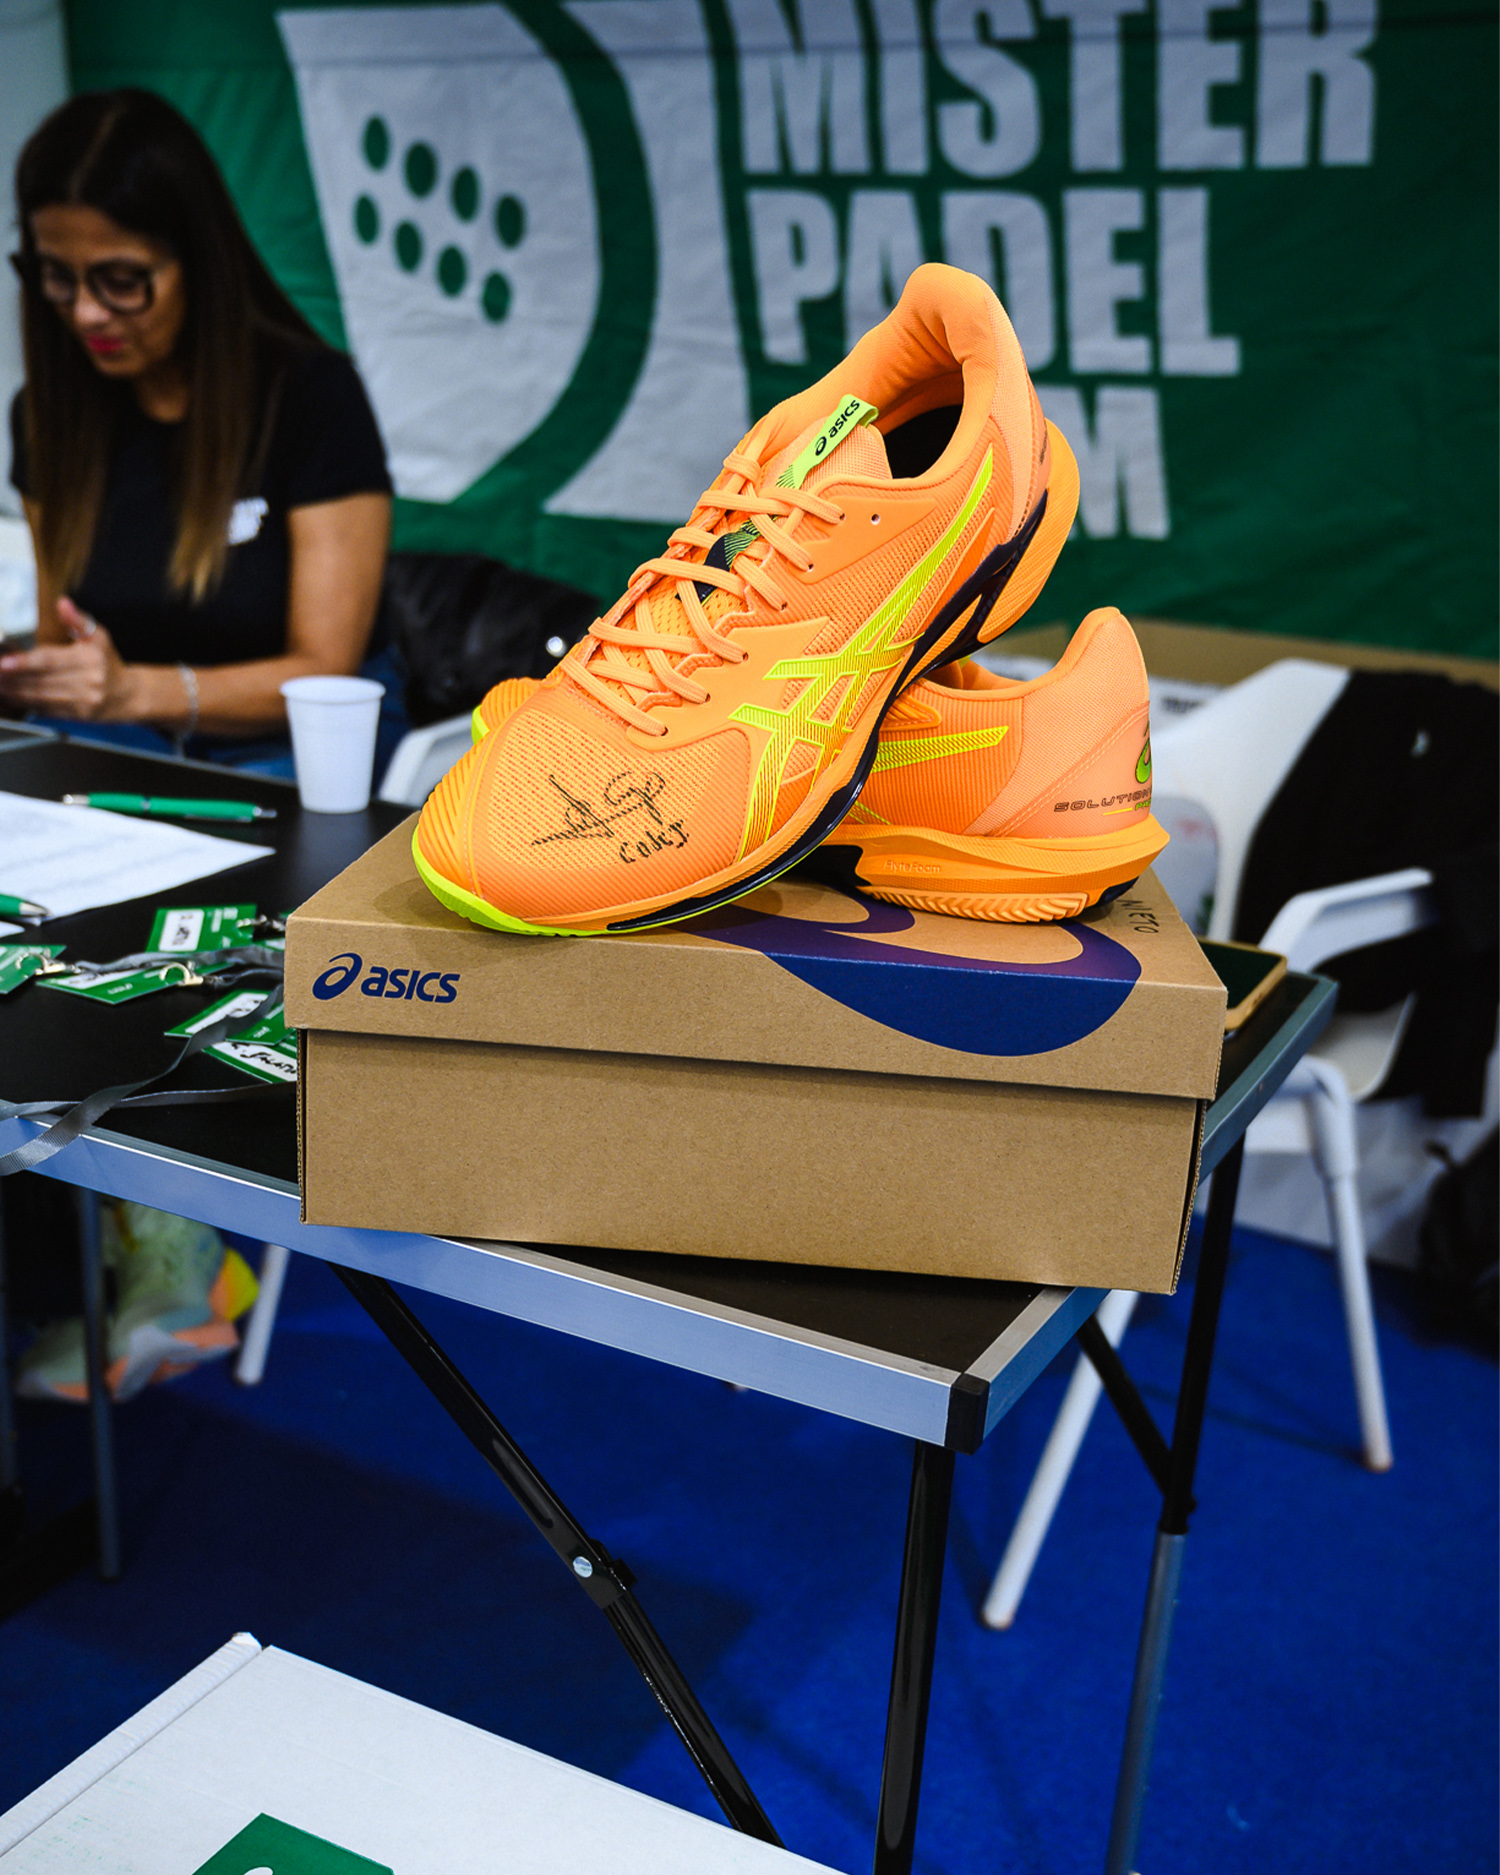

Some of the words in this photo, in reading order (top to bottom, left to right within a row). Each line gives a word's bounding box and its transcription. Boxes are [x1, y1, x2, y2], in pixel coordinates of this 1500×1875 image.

[729, 0, 1378, 178] MISTER
[746, 186, 1240, 376] PADEL
[828, 399, 861, 439] asics
[1053, 788, 1150, 813] SOLUTION
[360, 965, 461, 1004] asics
